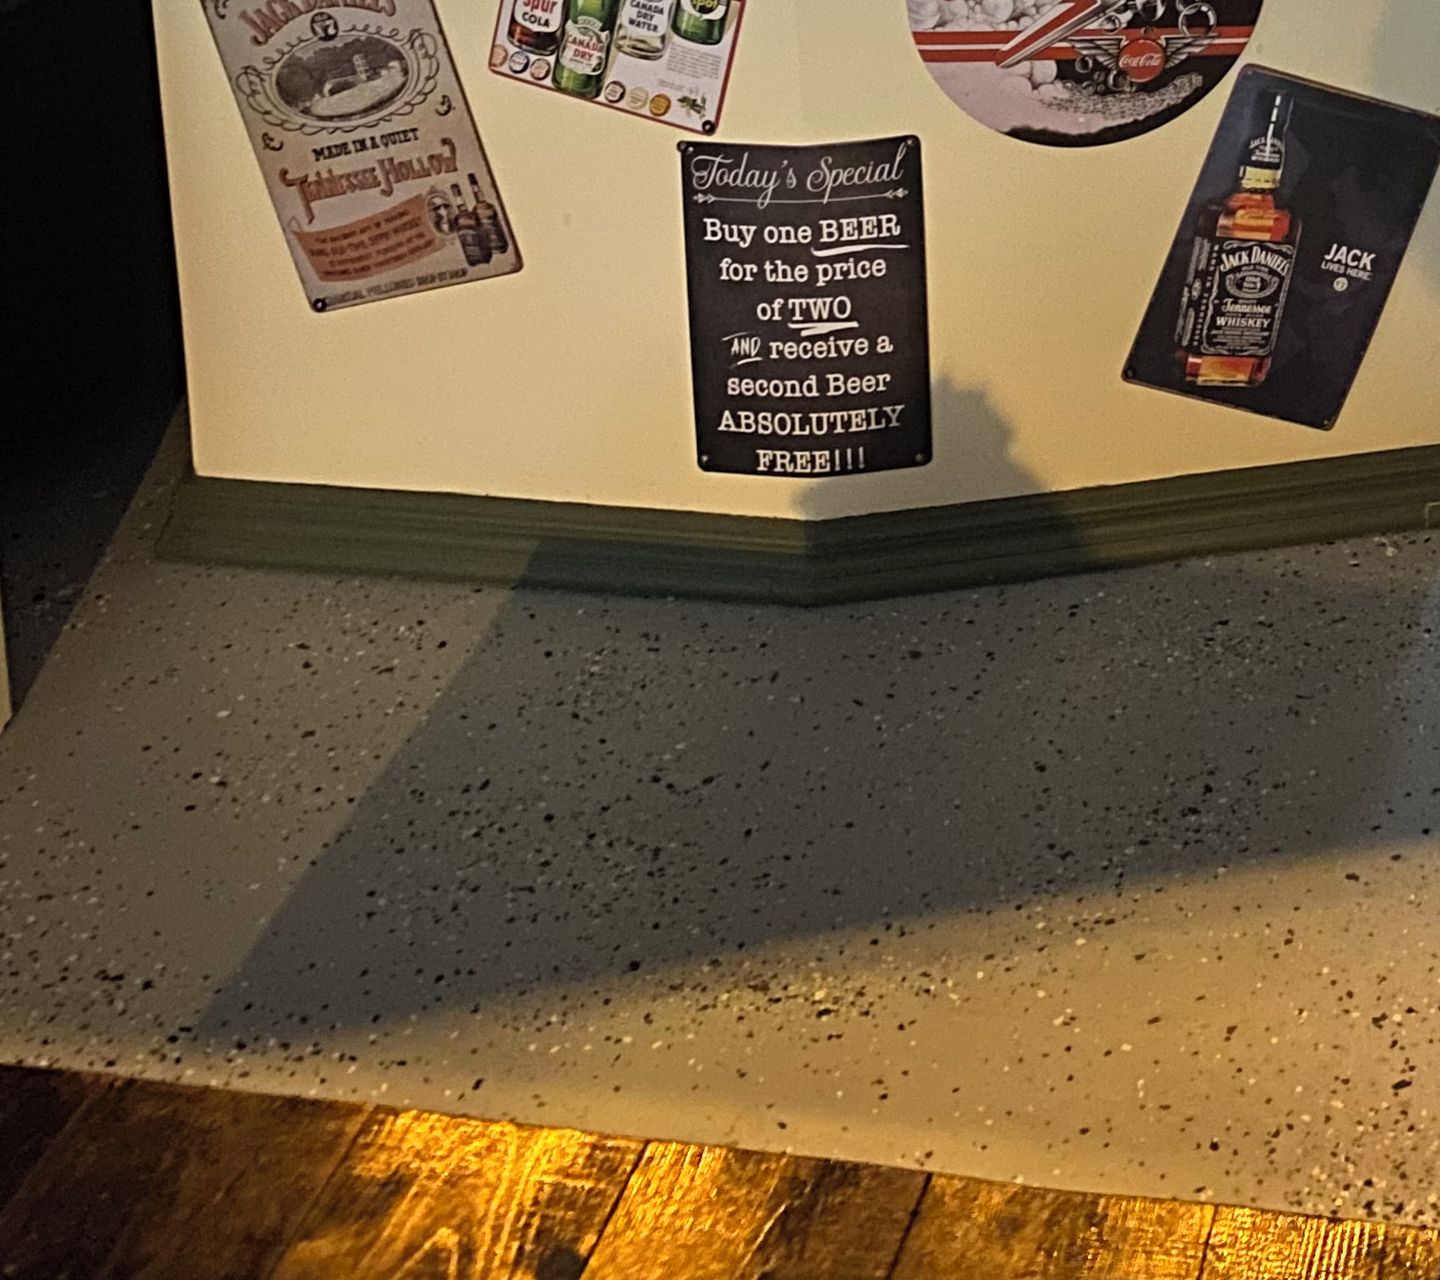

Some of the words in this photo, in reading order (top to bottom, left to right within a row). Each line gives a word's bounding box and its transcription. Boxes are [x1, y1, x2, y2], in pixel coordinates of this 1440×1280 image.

[521, 11, 551, 28] COLA
[628, 17, 659, 33] WATER
[636, 10, 655, 23] DRY
[566, 33, 605, 54] CANADA
[573, 46, 595, 62] DRY
[1119, 51, 1162, 68] Coca-Cola
[312, 143, 351, 161] MADE
[352, 140, 367, 153] IN
[367, 137, 380, 149] A
[381, 128, 419, 150] QUIET
[378, 138, 458, 197] HOLLOW
[691, 152, 797, 209] Today's
[807, 142, 907, 204] Special
[703, 218, 757, 248] Buy
[764, 225, 812, 243] one
[819, 214, 901, 242] BEER
[1220, 250, 1250, 272] JACK
[1321, 260, 1346, 274] LIVES
[1324, 243, 1376, 270] JACK
[720, 258, 758, 281] for
[764, 260, 808, 282] the
[816, 258, 886, 286] price
[757, 298, 784, 320] of
[788, 296, 851, 320] TWO
[1221, 298, 1272, 314] Tennessee
[1216, 316, 1271, 328] WHISKEY
[731, 337, 761, 357] AND
[769, 336, 868, 359] receive
[876, 335, 893, 353] a
[728, 375, 819, 397] second
[826, 373, 891, 396] Beer
[718, 405, 905, 436] ABSOLUTELY
[756, 447, 865, 473] FREE!!!
